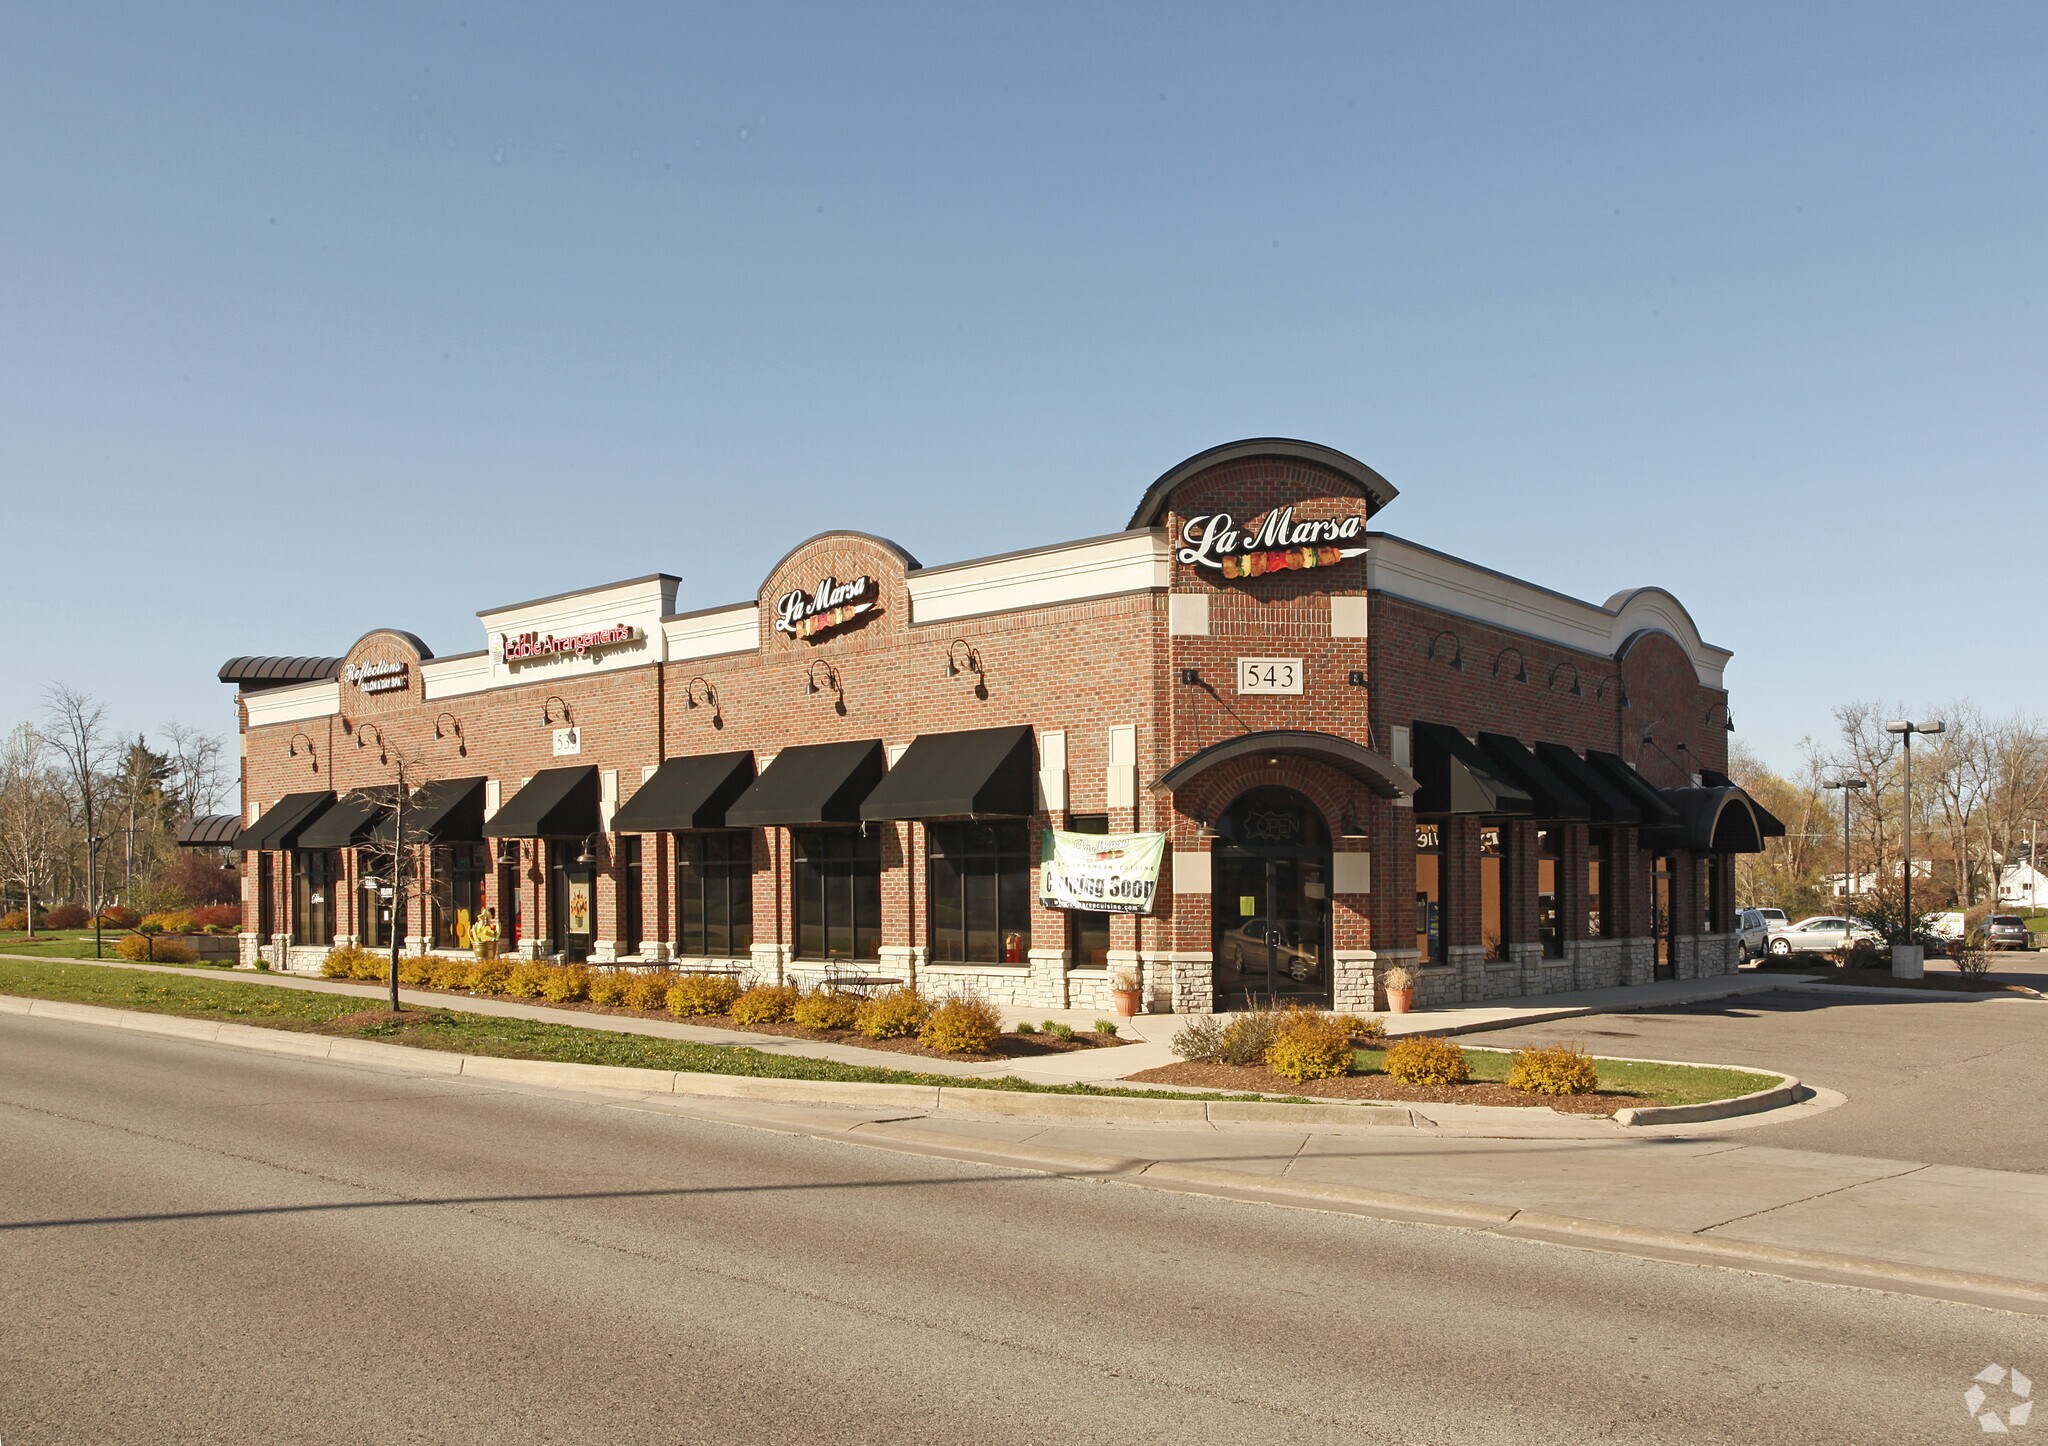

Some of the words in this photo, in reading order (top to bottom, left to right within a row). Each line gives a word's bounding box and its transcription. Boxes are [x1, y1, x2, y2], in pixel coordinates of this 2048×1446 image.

[1178, 513, 1237, 569] La
[1243, 506, 1362, 549] Marsa
[775, 589, 804, 632] La
[805, 576, 866, 615] Marsa
[505, 633, 541, 660] Edible
[542, 624, 629, 656] Arrangements
[344, 660, 401, 685] Reflections
[1247, 664, 1294, 688] 543
[1256, 818, 1300, 833] OPEN
[1046, 871, 1106, 898] Cing
[1109, 875, 1156, 899] Soon
